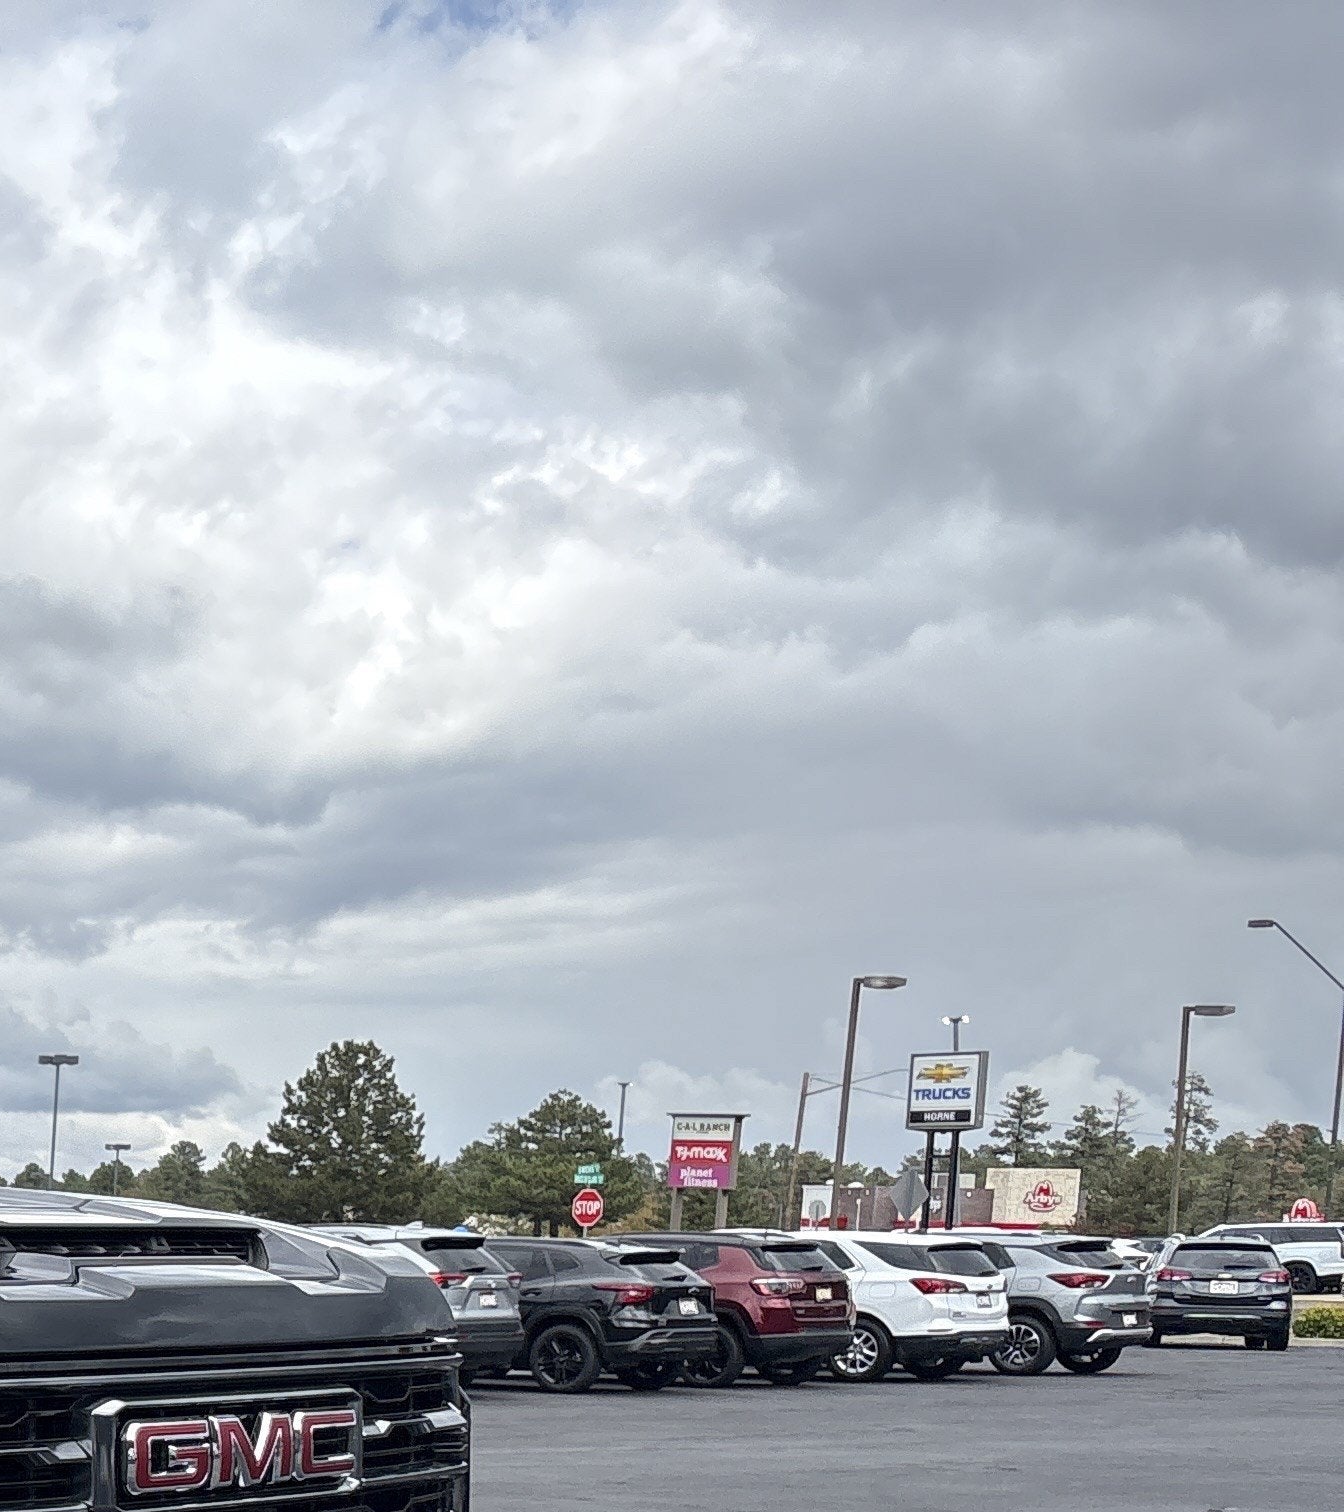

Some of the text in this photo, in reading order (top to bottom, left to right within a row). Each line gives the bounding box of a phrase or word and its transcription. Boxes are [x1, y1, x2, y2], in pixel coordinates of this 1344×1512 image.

[913, 1087, 972, 1101] TRUCKS
[923, 1111, 957, 1122] HORNE
[699, 1123, 731, 1132] RANCH
[679, 1166, 714, 1179] planet
[574, 1200, 601, 1215] STOP
[124, 1409, 357, 1497] GMC
